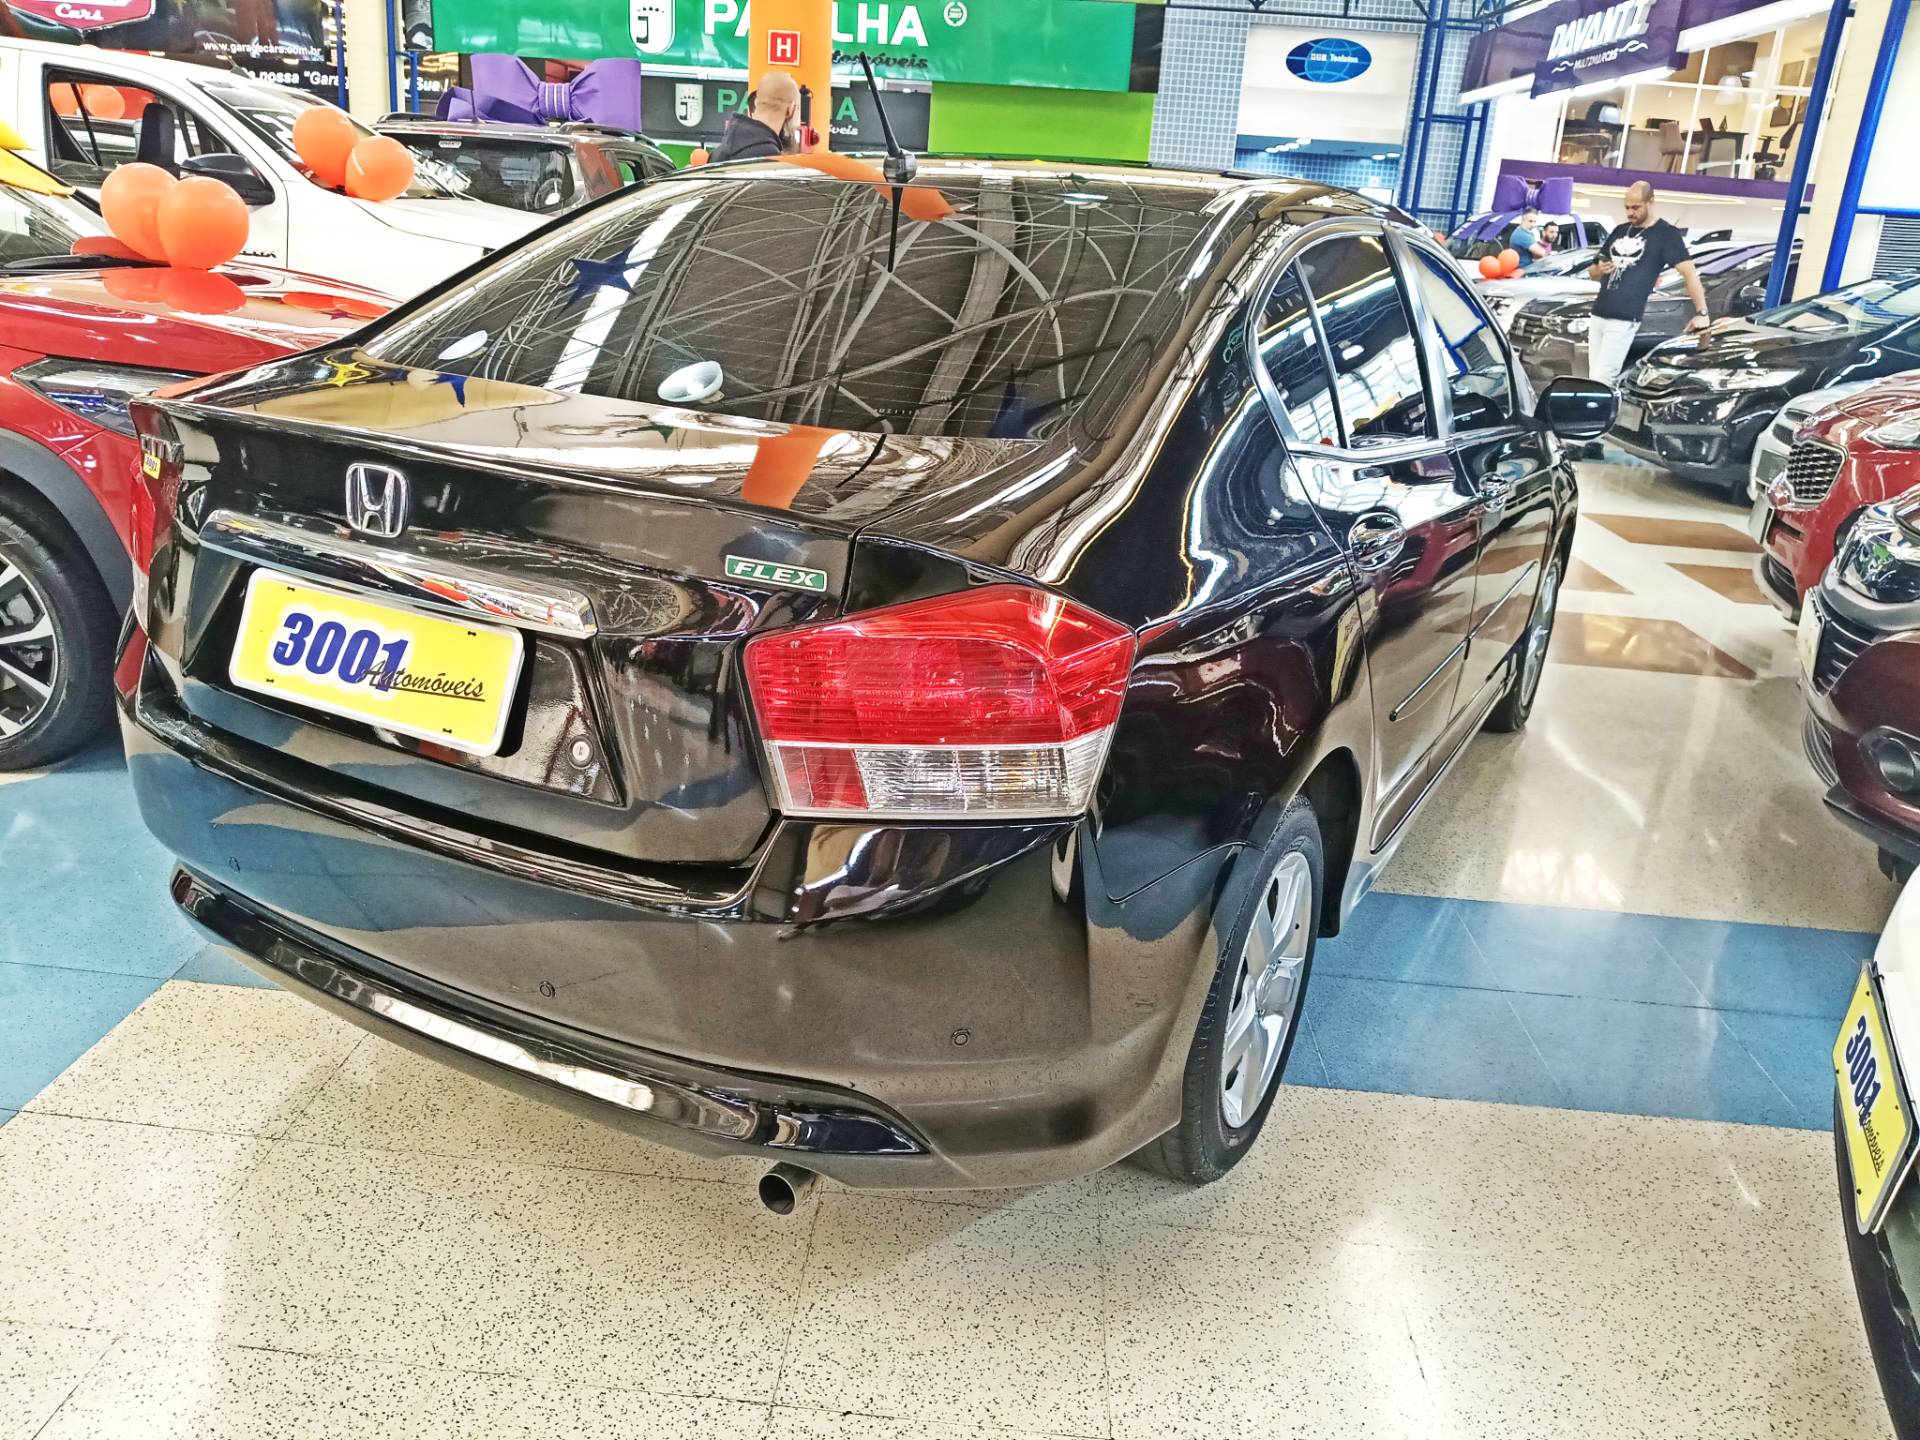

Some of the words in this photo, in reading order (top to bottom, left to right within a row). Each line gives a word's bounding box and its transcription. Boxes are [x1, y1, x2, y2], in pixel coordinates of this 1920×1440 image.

[55, 3, 104, 21] Cars
[1547, 0, 1656, 61] DAVANTI
[203, 41, 322, 56] www.garagecars.com.br
[776, 37, 792, 58] H
[259, 71, 299, 84] nossa
[733, 561, 818, 587] FLEX
[273, 612, 409, 692] 3001
[363, 659, 486, 702] Automóveis
[1846, 1015, 1882, 1126] 3001
